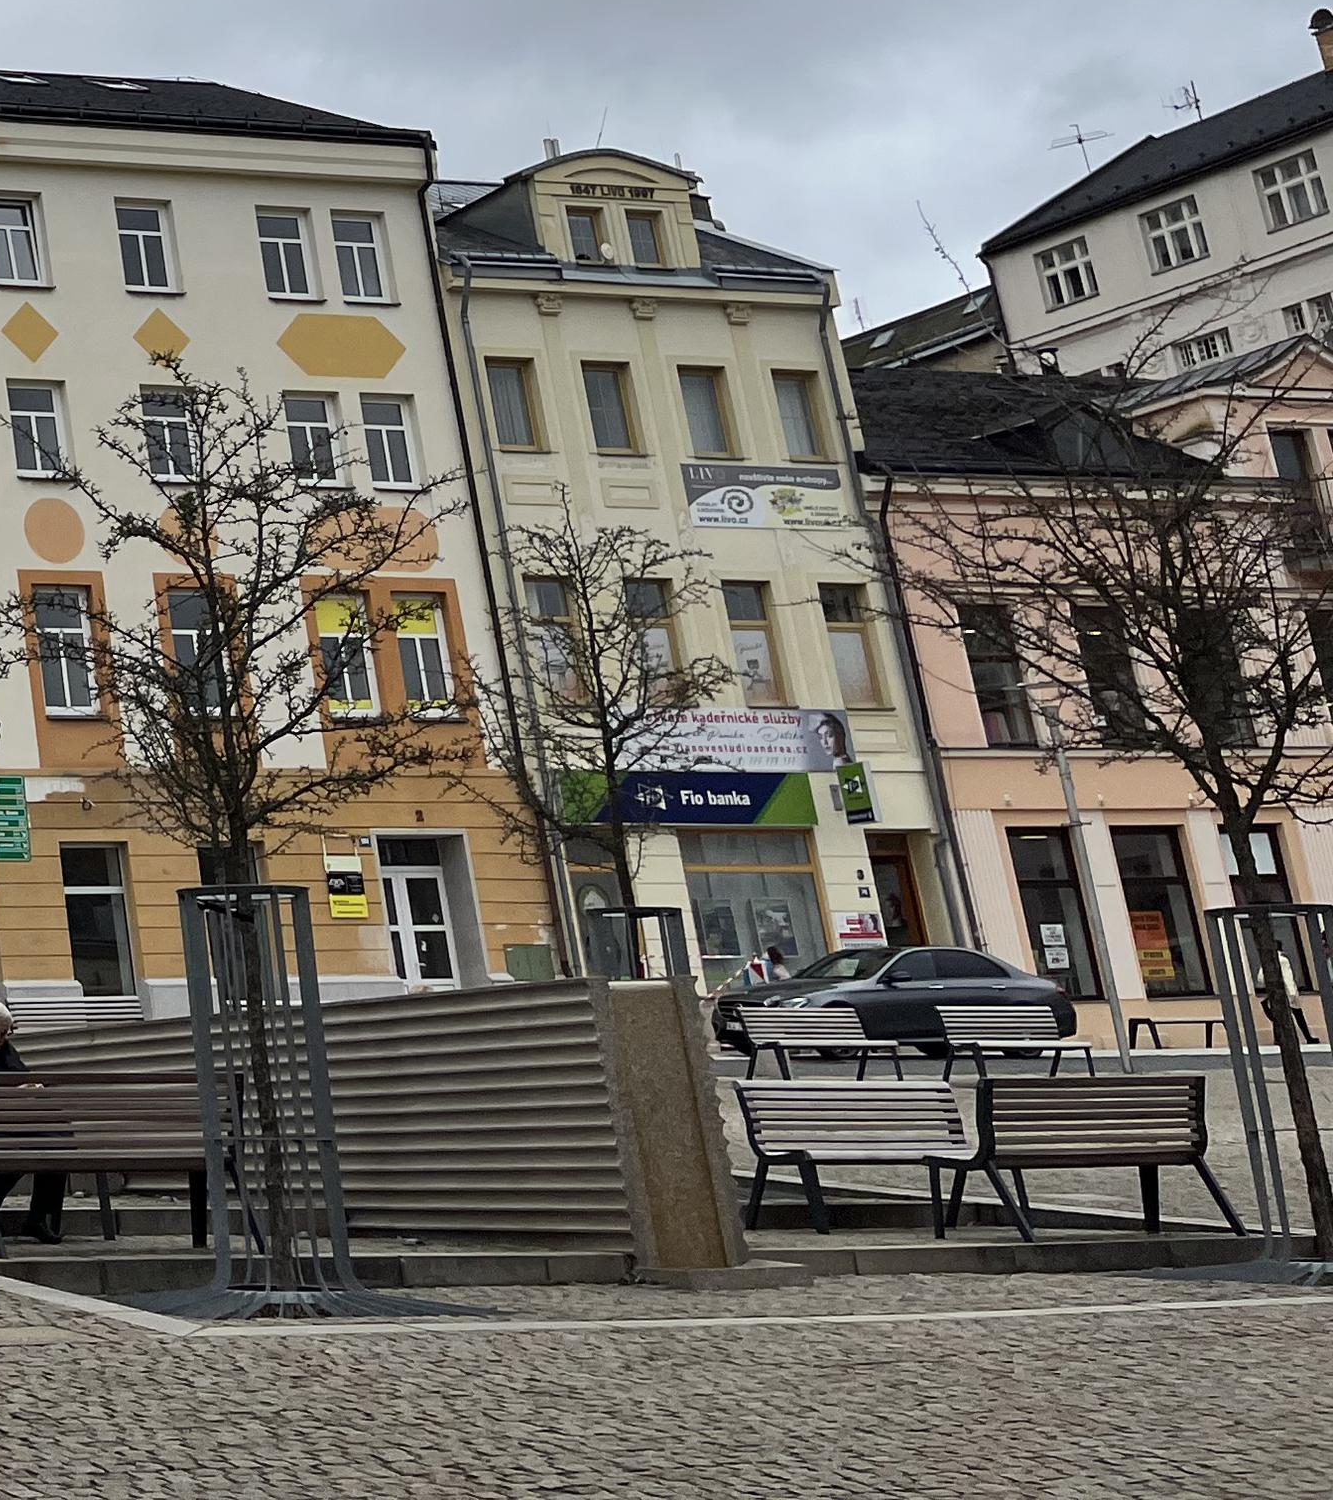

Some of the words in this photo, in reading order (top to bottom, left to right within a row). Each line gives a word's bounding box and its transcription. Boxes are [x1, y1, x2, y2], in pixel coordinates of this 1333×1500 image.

[692, 710, 759, 724] kadeřnické
[763, 712, 802, 727] služby
[680, 789, 704, 805] Fio
[707, 790, 751, 806] banka
